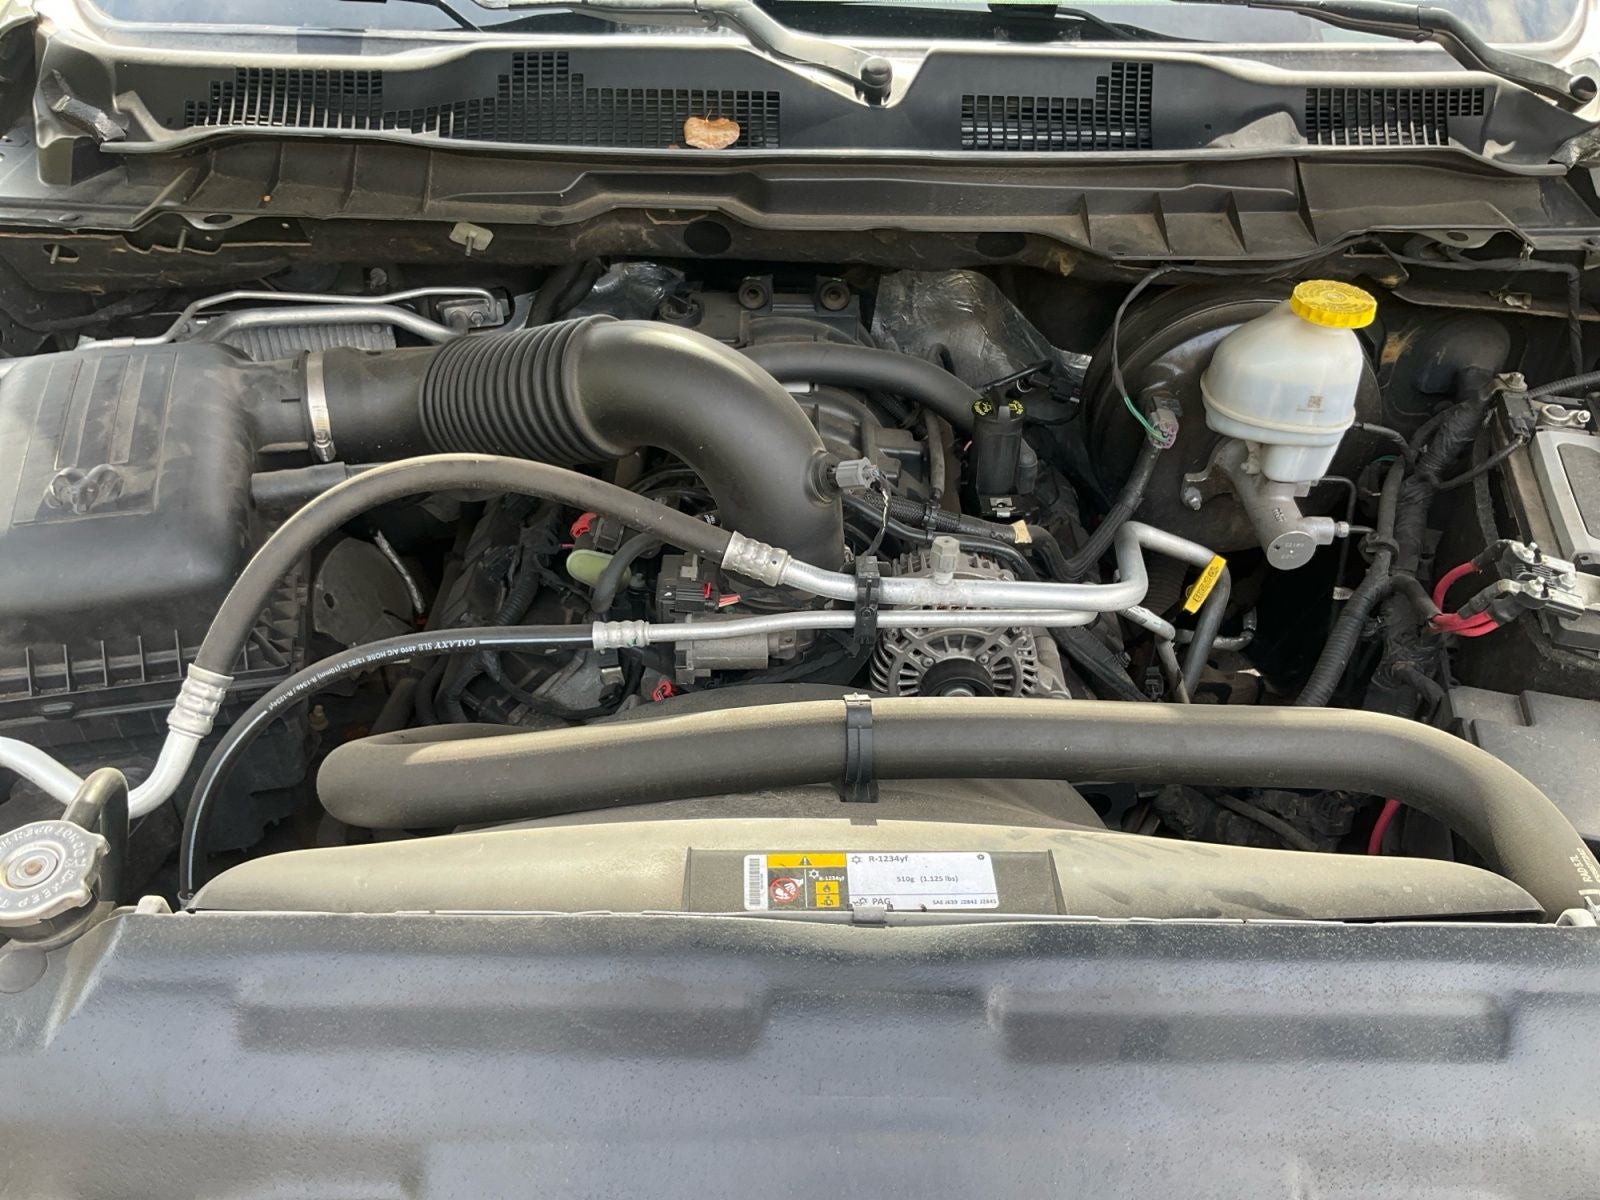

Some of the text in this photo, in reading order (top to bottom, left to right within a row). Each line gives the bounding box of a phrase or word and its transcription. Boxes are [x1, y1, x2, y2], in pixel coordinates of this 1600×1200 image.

[418, 641, 433, 650] SLE
[435, 638, 476, 649] GALAXY
[386, 648, 400, 657] A/C
[868, 855, 908, 864] R-1234yf
[896, 876, 915, 884] 510g
[944, 876, 959, 884] lbs)
[871, 897, 891, 905] PAG
